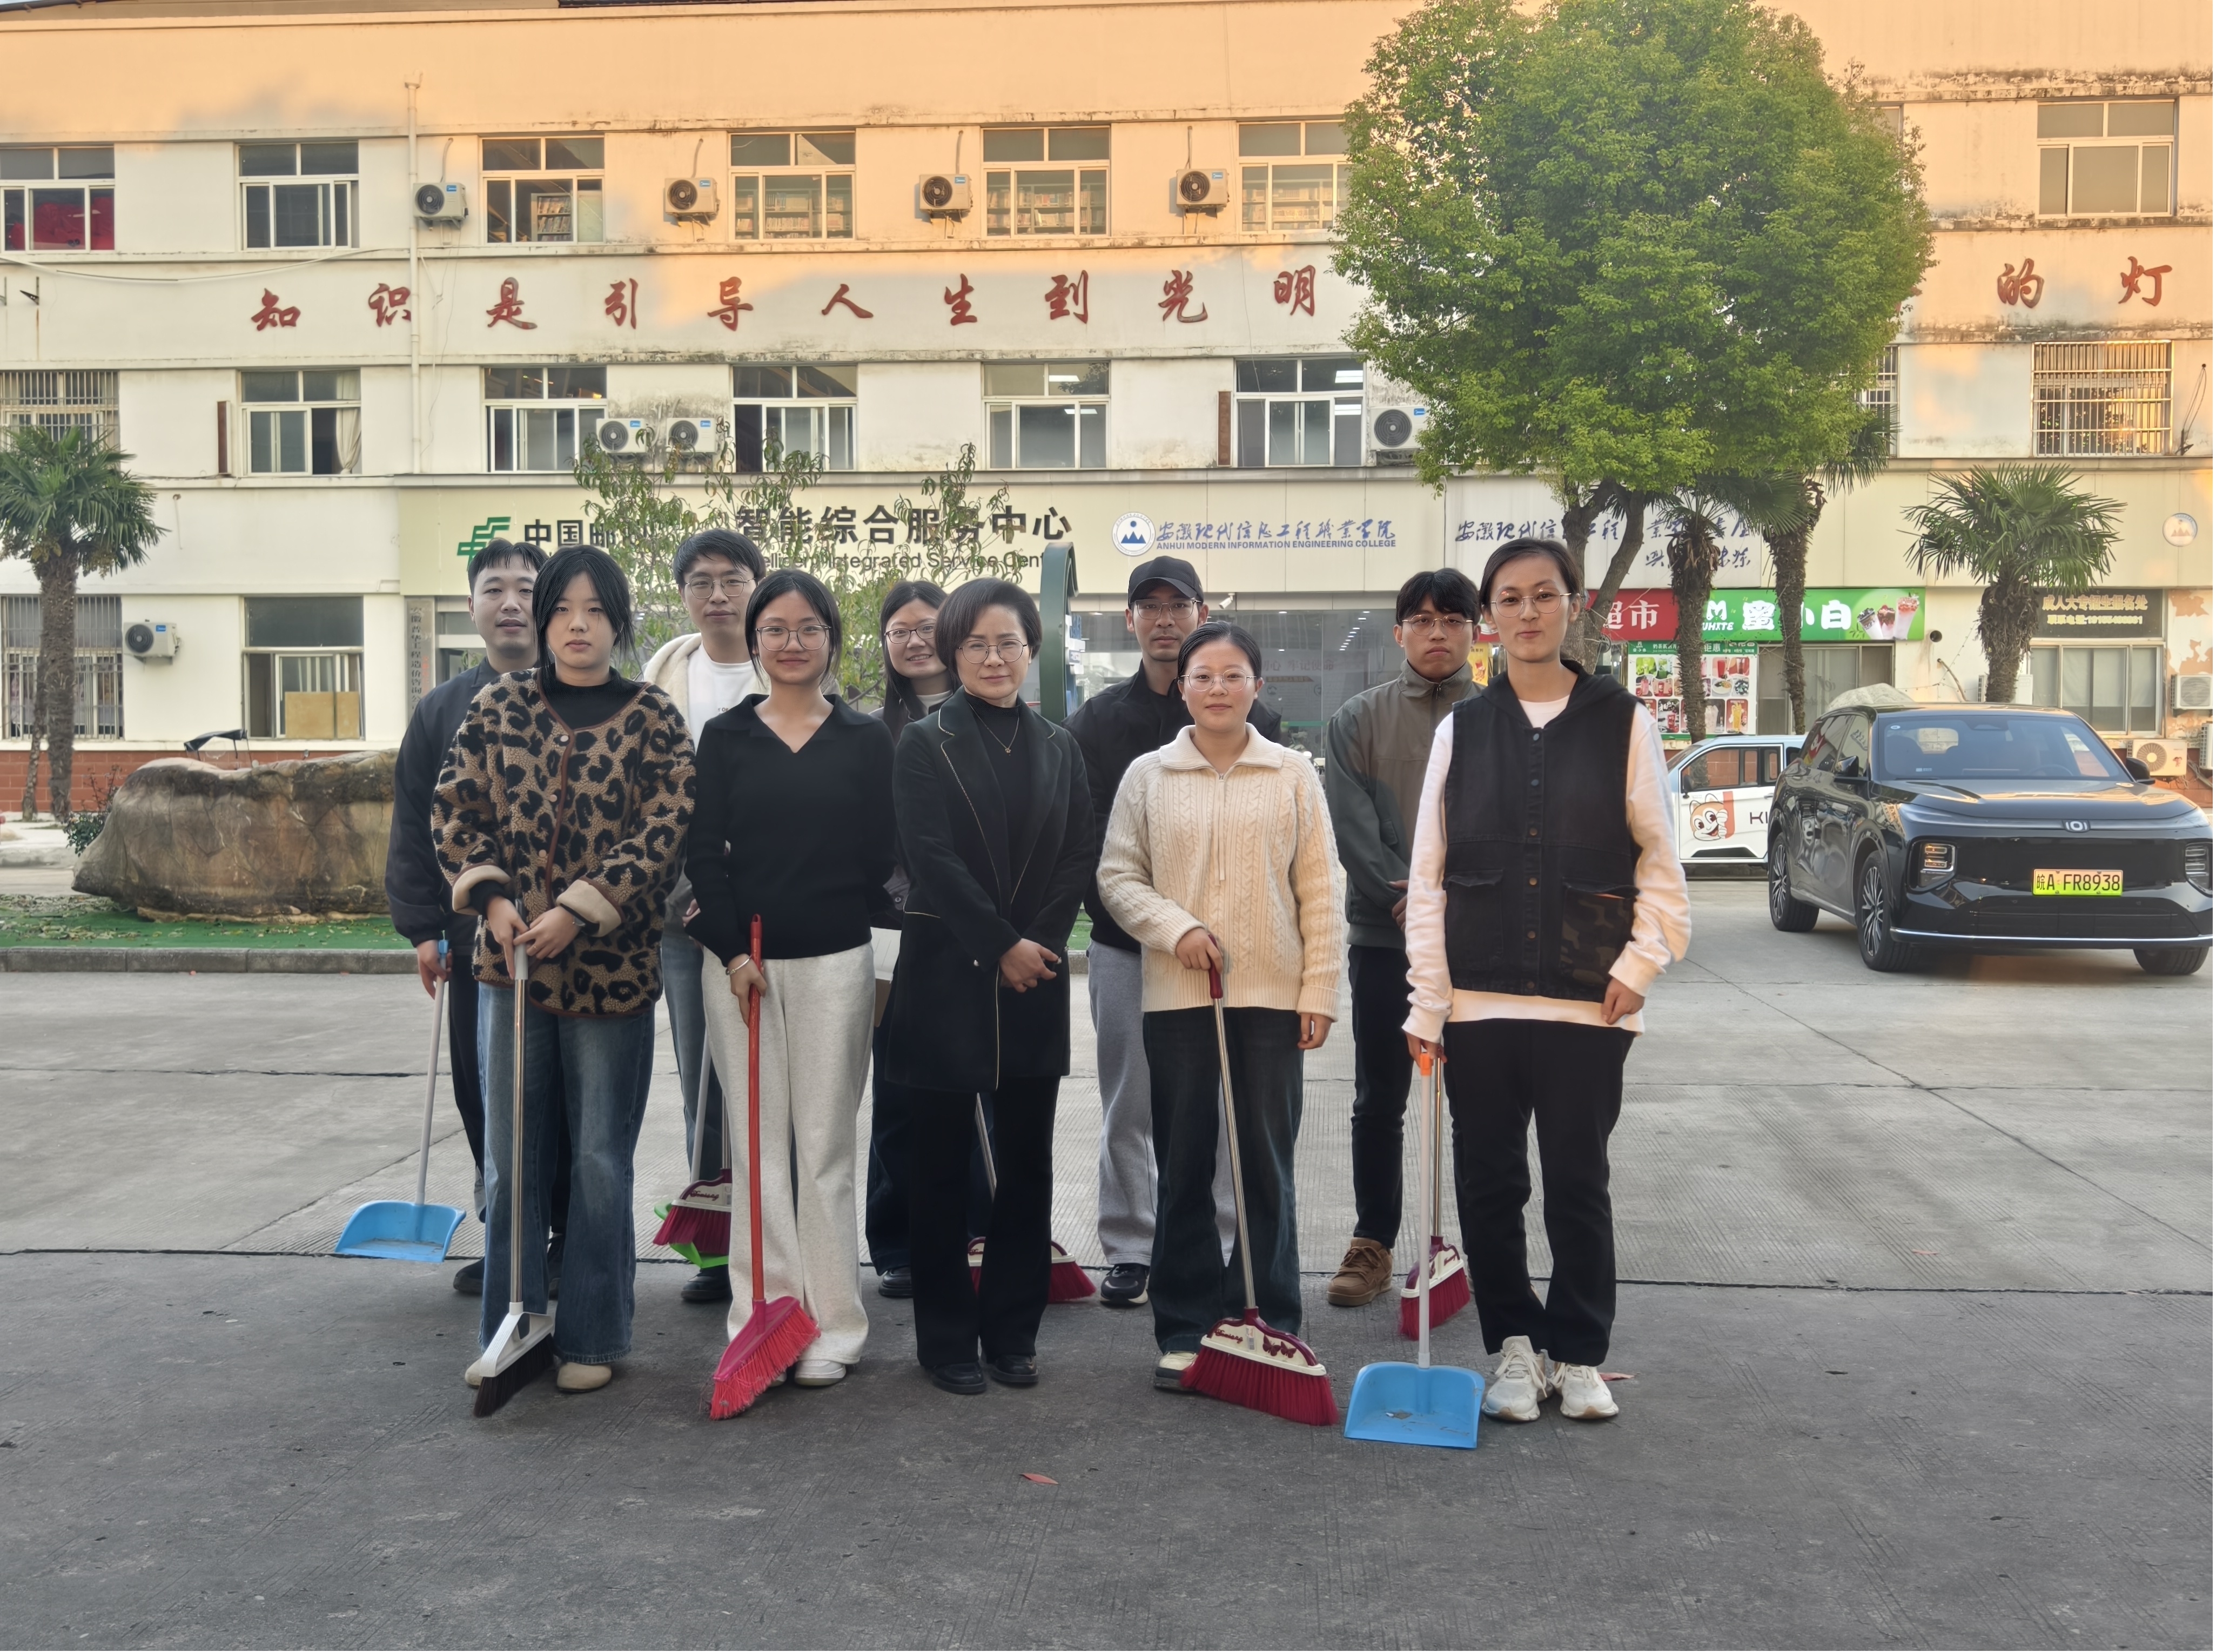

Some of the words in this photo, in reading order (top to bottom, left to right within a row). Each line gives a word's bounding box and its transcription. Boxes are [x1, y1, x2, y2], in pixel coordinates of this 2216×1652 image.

[1997, 256, 2172, 308] 的灯
[525, 519, 648, 548] 中国邮
[1228, 541, 1290, 549] INFORMATION
[1292, 540, 1353, 548] ENGINEERING
[928, 552, 998, 568] Servce
[2042, 594, 2148, 610] 成人大专招生报名处
[2036, 874, 2055, 890] 皖A
[2063, 874, 2120, 891] FR8938
